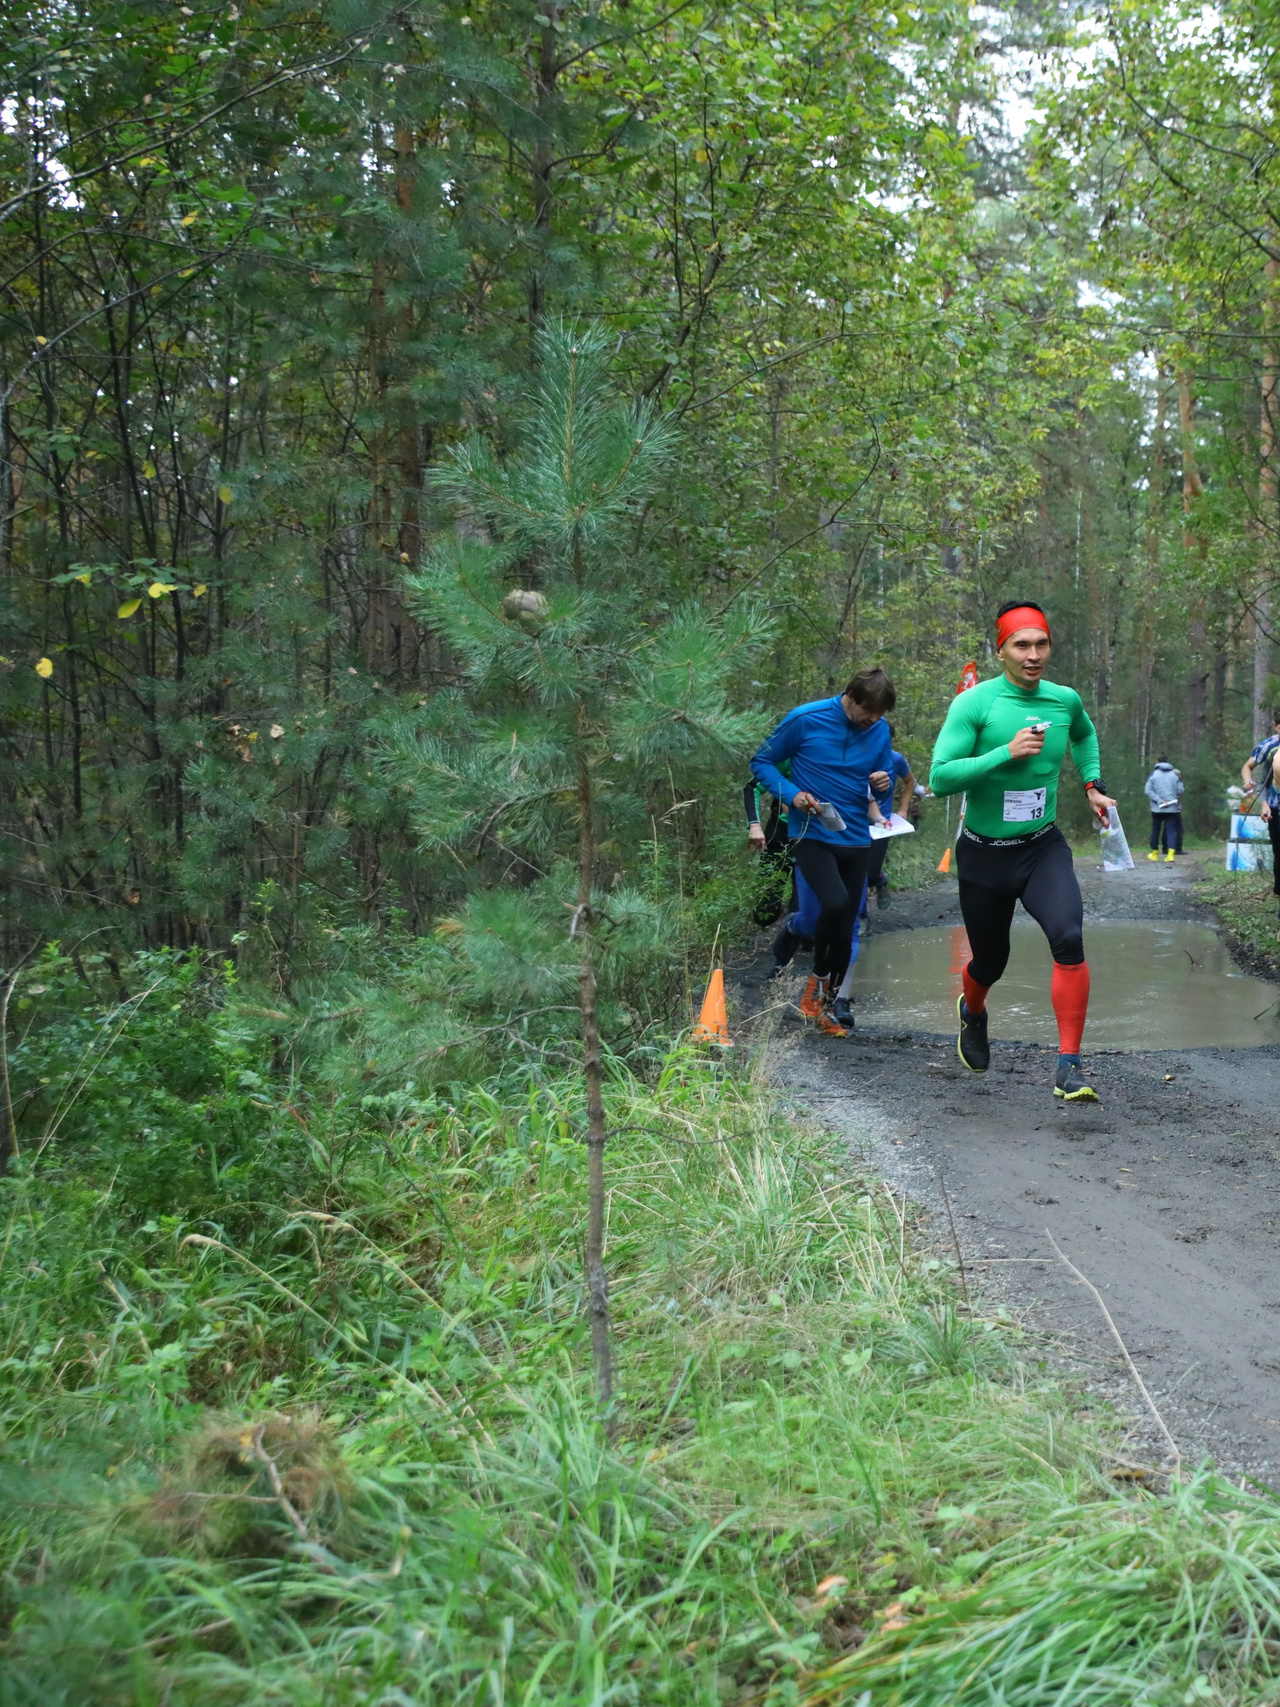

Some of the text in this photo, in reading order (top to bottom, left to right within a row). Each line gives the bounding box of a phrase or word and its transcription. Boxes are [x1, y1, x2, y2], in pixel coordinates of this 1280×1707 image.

[1031, 807, 1043, 819] 13
[963, 827, 983, 844] ÖGEL
[988, 838, 1026, 847] JÖGEL
